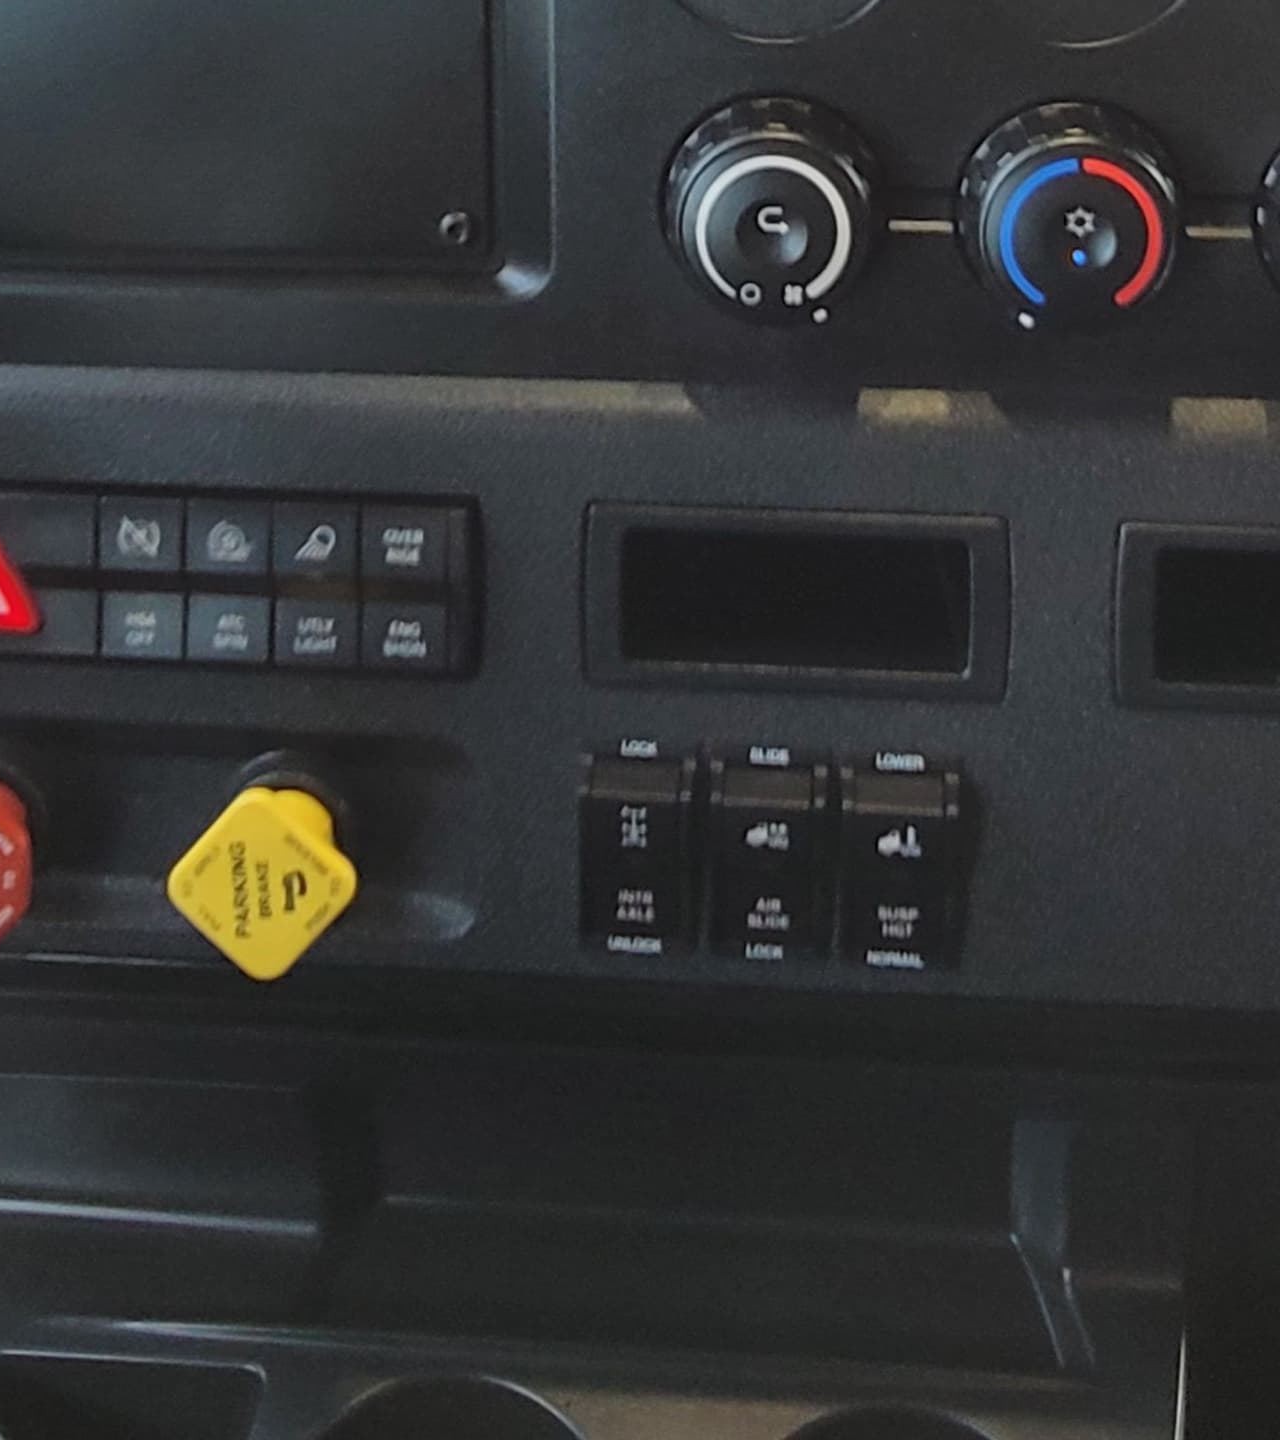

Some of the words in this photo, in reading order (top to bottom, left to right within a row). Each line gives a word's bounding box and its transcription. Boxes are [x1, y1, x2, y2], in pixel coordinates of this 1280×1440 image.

[621, 739, 658, 757] LOCK
[875, 752, 925, 771] LOWER
[228, 840, 251, 940] PARKING
[255, 860, 273, 918] BRAKE
[756, 897, 781, 912] AIR
[745, 942, 783, 959] LOCK
